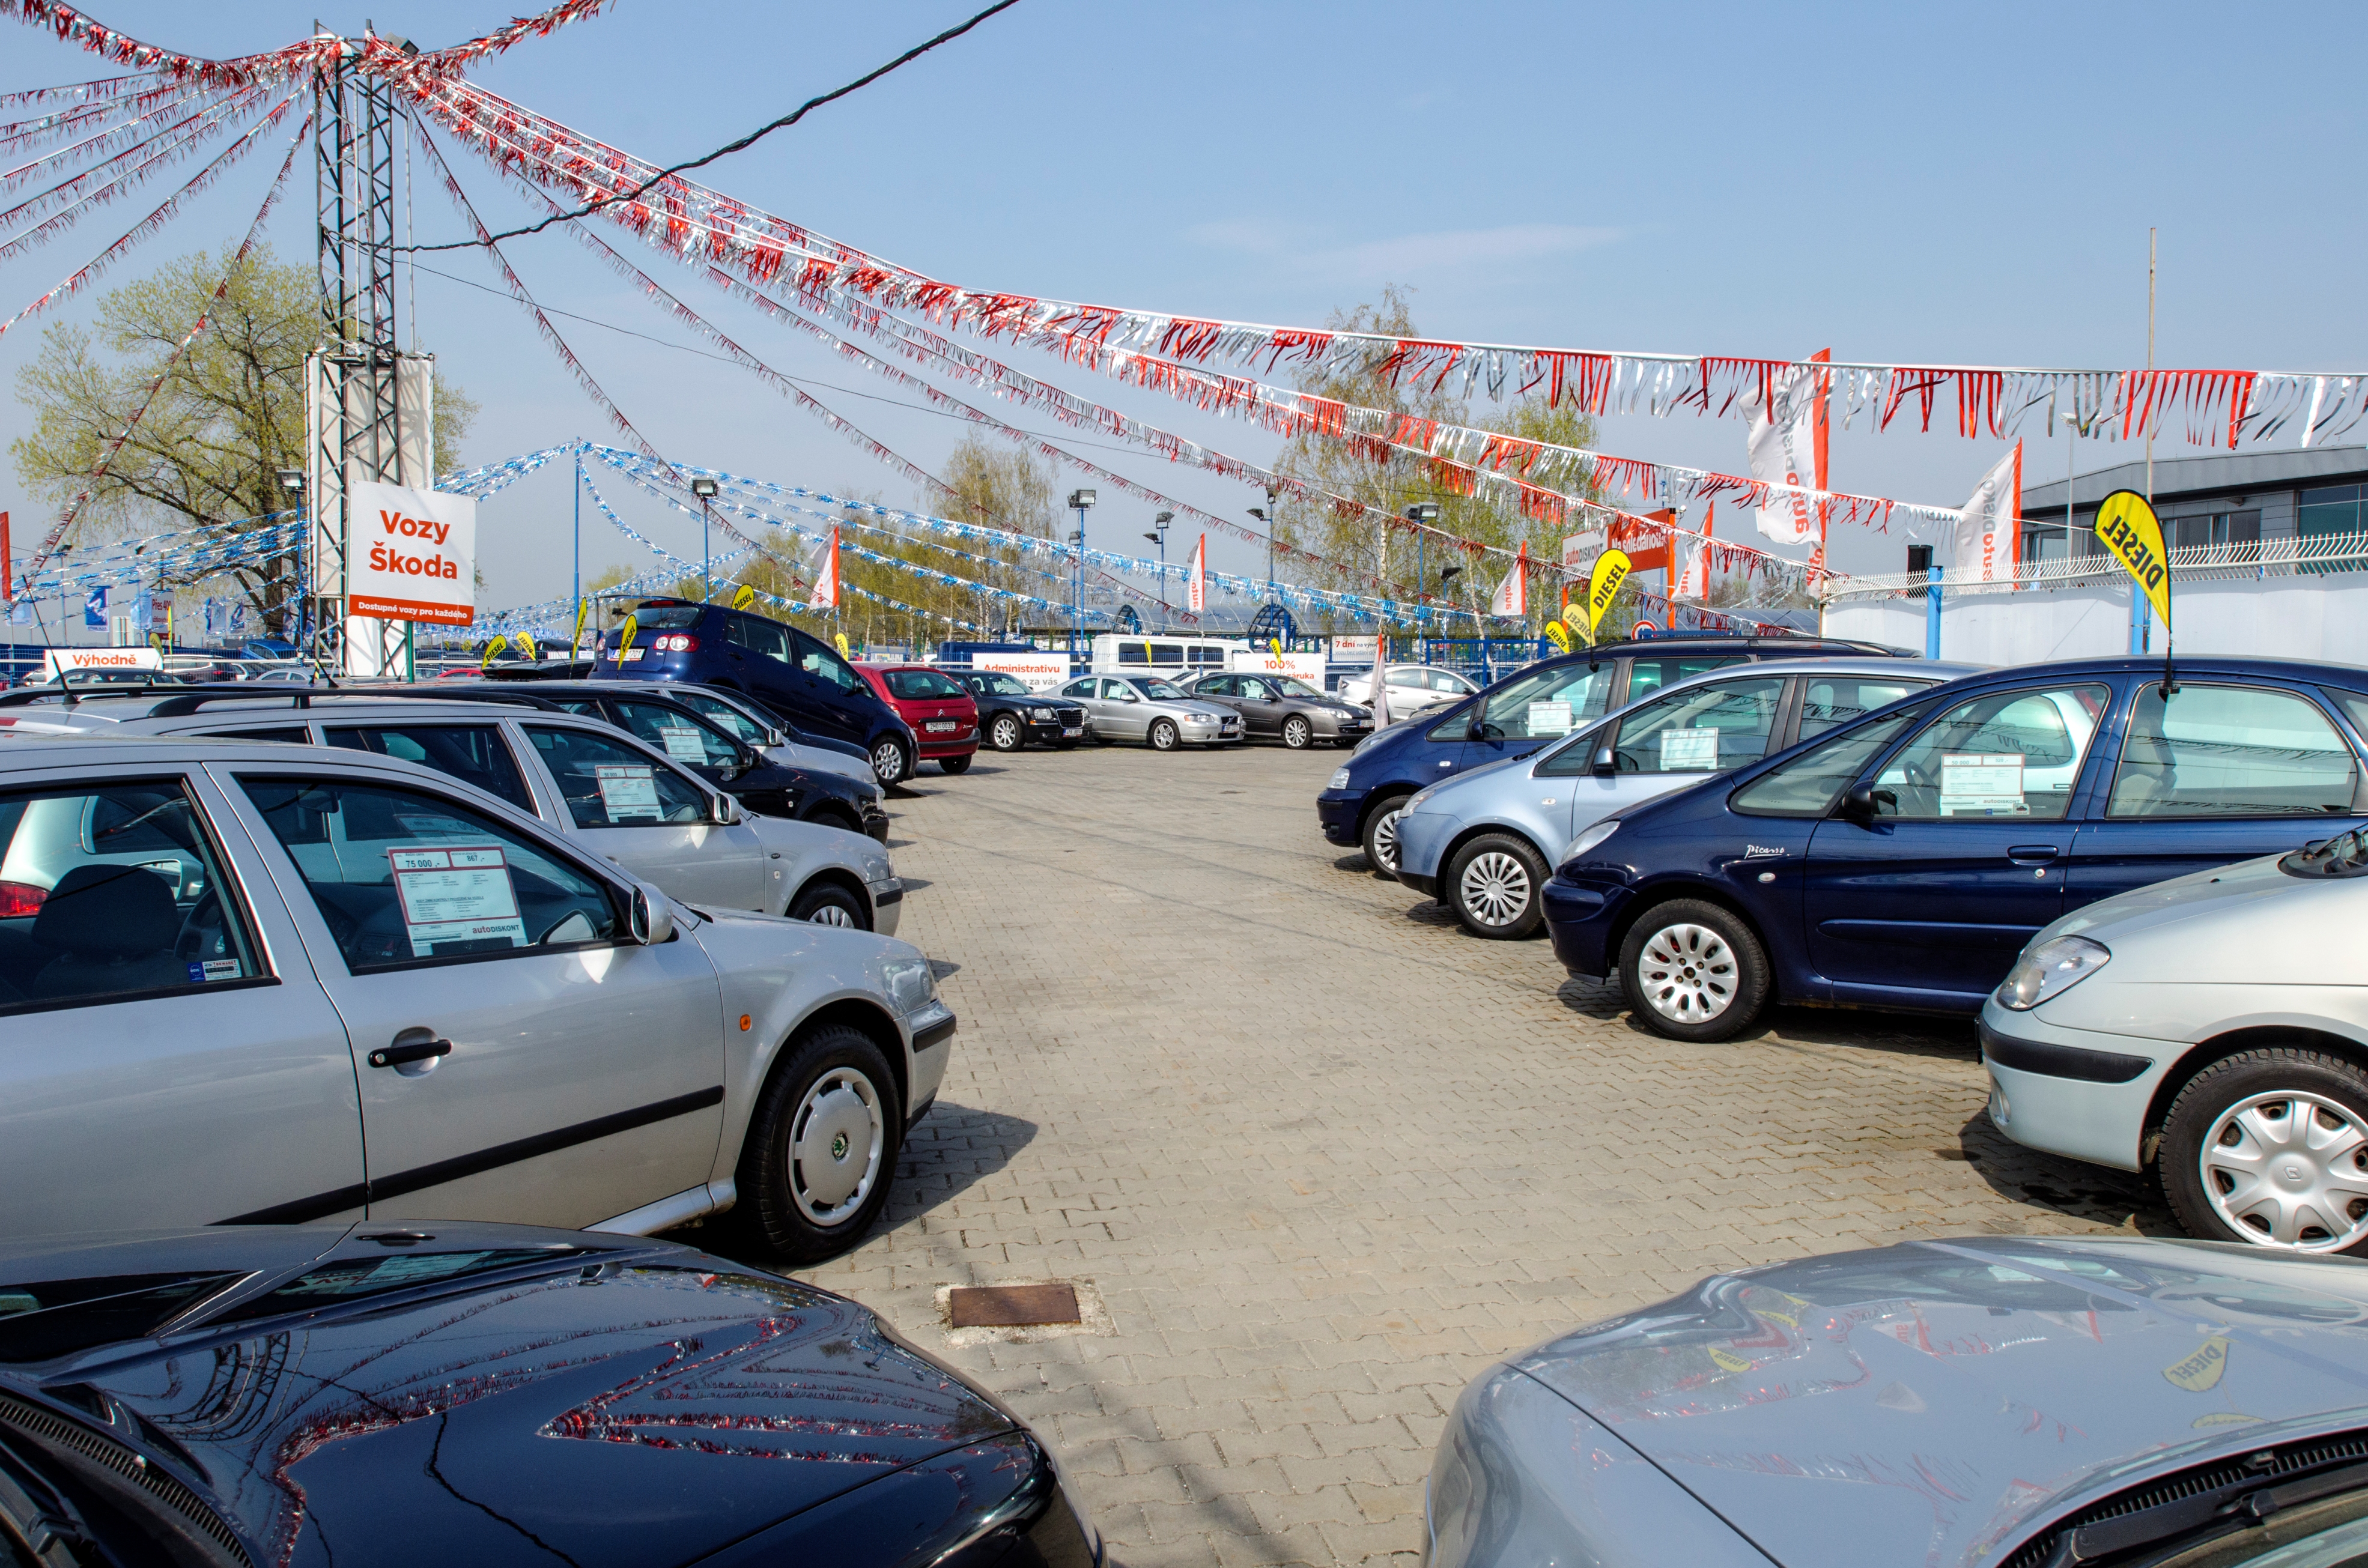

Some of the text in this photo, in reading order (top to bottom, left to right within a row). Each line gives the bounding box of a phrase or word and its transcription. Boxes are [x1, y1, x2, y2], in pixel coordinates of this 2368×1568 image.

[379, 509, 450, 545] Vozy
[369, 540, 458, 580] Škoda
[1565, 543, 1603, 566] autoDISKONT
[1593, 563, 1627, 610] DIESEL
[152, 598, 163, 610] Přes
[734, 593, 752, 610] DIESEL
[358, 602, 467, 619] Dostupné vozy pro každého
[575, 611, 586, 646] DIESEL
[622, 626, 636, 653] DIESEL
[486, 642, 504, 661] DIESEL
[72, 654, 136, 667] Výhodně
[984, 664, 1060, 673] Administrativu
[1264, 660, 1296, 670] 100%
[1042, 677, 1058, 685] vás
[1744, 844, 1785, 859] Picasso
[472, 924, 520, 934] autoDISKONT
